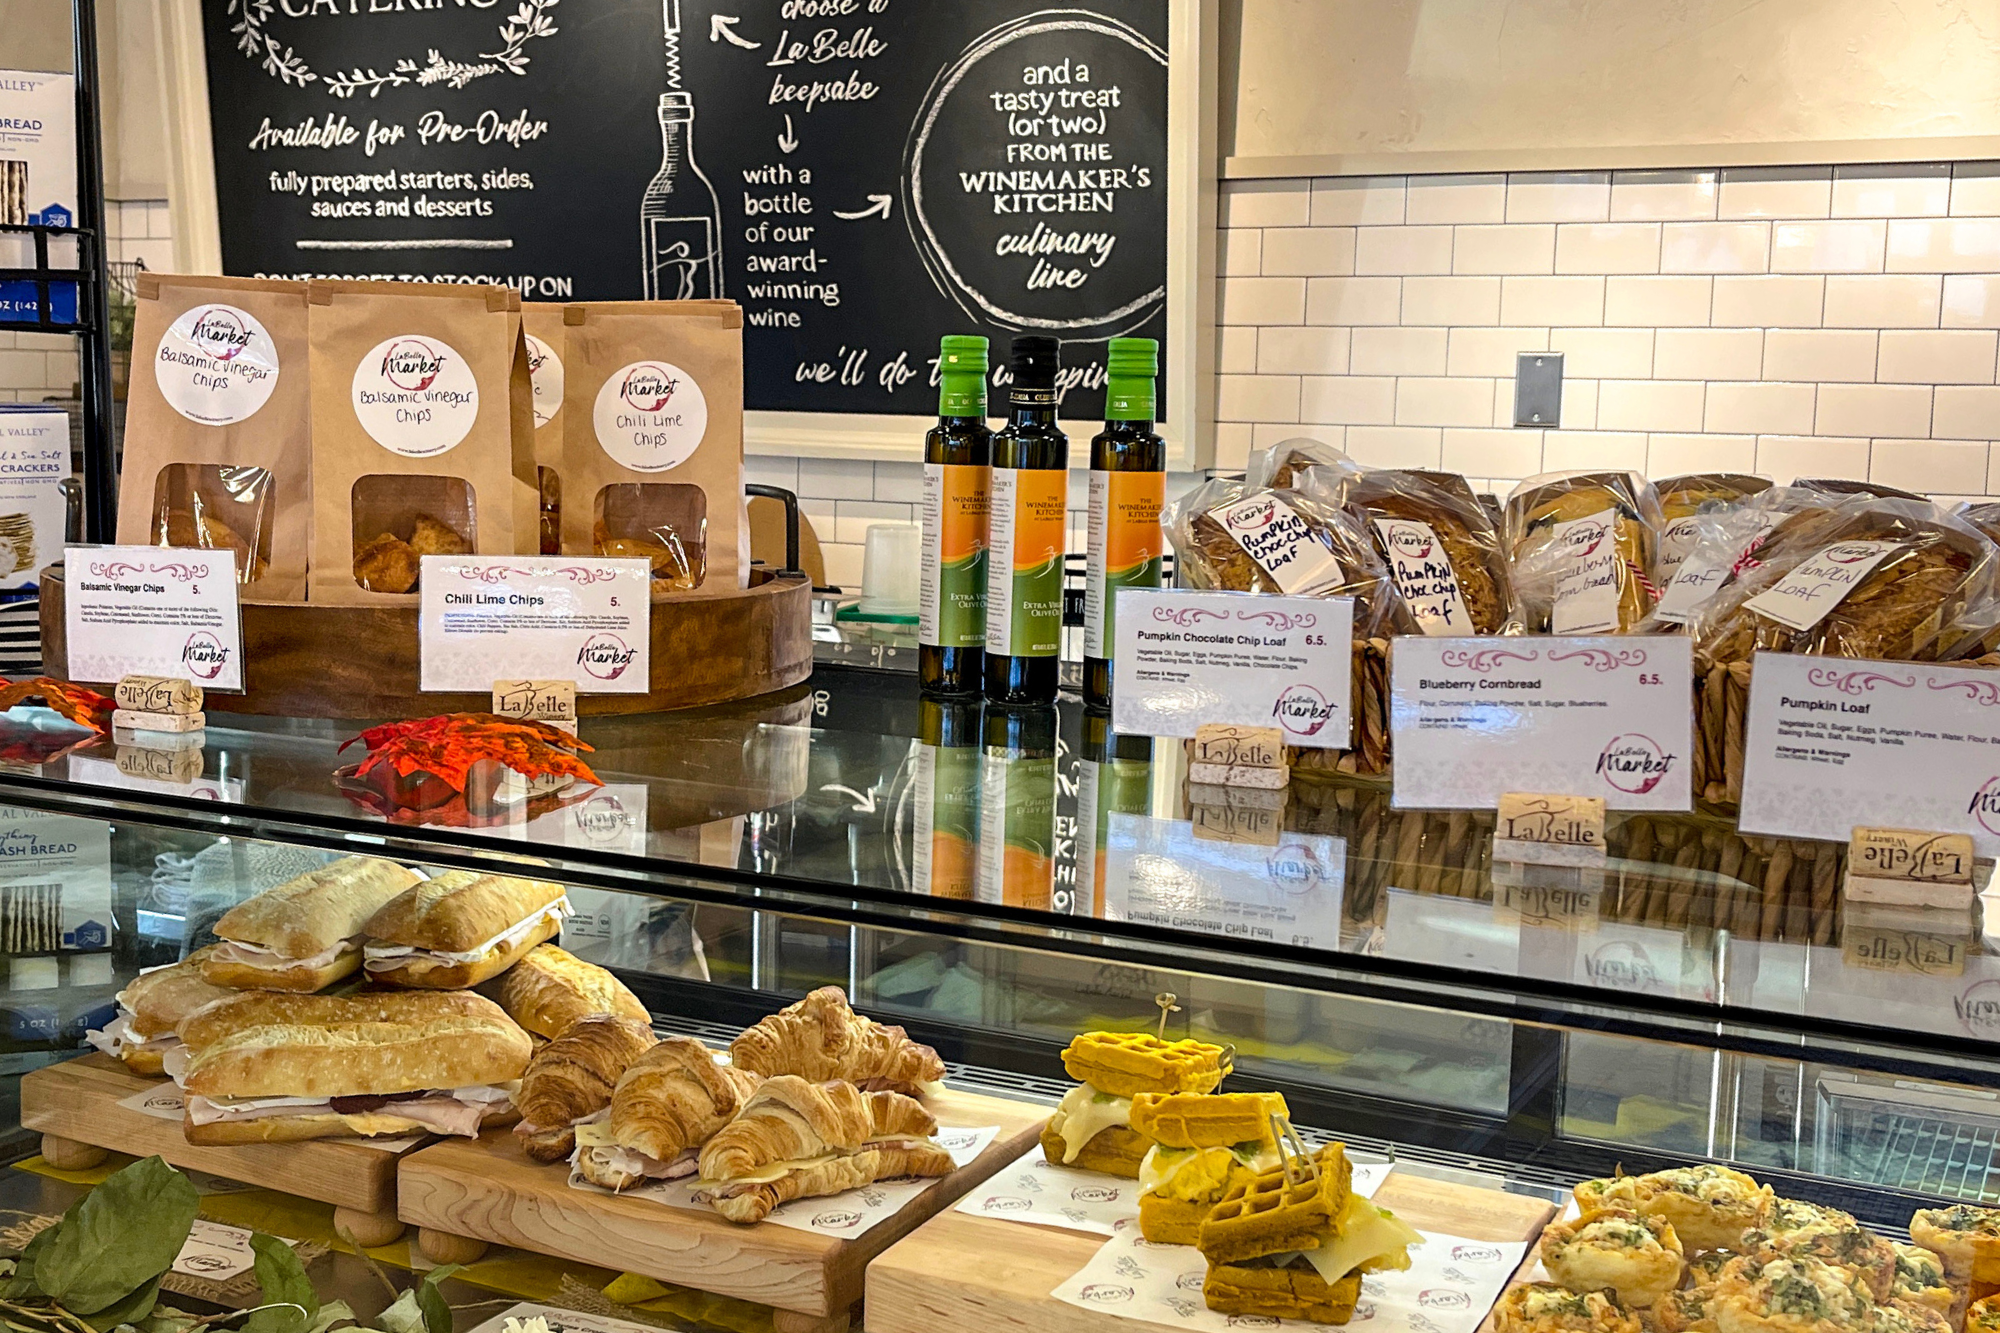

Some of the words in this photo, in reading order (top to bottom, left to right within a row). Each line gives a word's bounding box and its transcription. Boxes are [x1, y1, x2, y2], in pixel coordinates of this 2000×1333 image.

[1023, 59, 1071, 85] and
[1075, 65, 1090, 83] a
[768, 69, 880, 113] keepsake
[990, 90, 1055, 115] tasty
[1060, 86, 1121, 108] treat
[249, 113, 361, 151] Available
[364, 118, 406, 157] for
[417, 109, 550, 149] Pre-Order
[1008, 114, 1043, 137] (or
[1047, 113, 1106, 136] two)
[1006, 145, 1066, 163] FROM
[1068, 143, 1113, 161] THE
[270, 171, 308, 195] fully
[311, 169, 398, 194] prepared
[399, 171, 479, 193] starters,
[481, 167, 535, 191] sides,
[743, 165, 793, 186] with
[797, 168, 812, 185] a
[960, 164, 1152, 193] WINEMAKER'S
[311, 199, 372, 219] sauces
[375, 195, 410, 217] and
[413, 194, 494, 218] desserts
[744, 193, 813, 215] bottle
[992, 191, 1115, 214] KITCHEN
[745, 222, 770, 244] of
[773, 225, 815, 243] our
[996, 222, 1116, 268] culinary
[747, 251, 829, 273] award-
[1027, 258, 1089, 291] line
[539, 275, 574, 298] ON
[748, 278, 840, 306] winning
[749, 309, 802, 329] wine
[191, 320, 256, 347] Market
[160, 346, 220, 372] Balsamic
[380, 355, 447, 377] Market
[795, 346, 868, 387] we'll
[879, 351, 917, 394] do
[360, 390, 422, 405] Balsamic
[620, 377, 681, 399] Market
[616, 413, 647, 429] Chili
[653, 414, 684, 428] Lime
[0, 463, 60, 473] CRACKERS
[80, 582, 112, 592] Balsamic
[113, 583, 142, 594] Vinegar
[143, 584, 165, 594] Chips
[951, 593, 974, 602] EXTRA
[445, 594, 472, 605] Chili
[476, 594, 506, 605] Lime
[509, 594, 544, 607] Chips
[1023, 602, 1047, 610] EXTRA
[1137, 630, 1181, 643] Pumpkin
[1183, 632, 1235, 645] Chocolate
[1237, 635, 1261, 647] Chip
[1263, 636, 1287, 647] Loaf
[182, 645, 231, 664] Market
[576, 648, 638, 665] Market
[1419, 678, 1476, 692] Blueberry
[1478, 678, 1542, 690] Cornbread
[1272, 698, 1339, 720] Market
[1780, 696, 1837, 712] Pumpkin
[1841, 701, 1871, 714] Loaf
[1596, 752, 1678, 774] Market
[1506, 811, 1595, 843] LaBelle
[31, 843, 77, 855] BREAD
